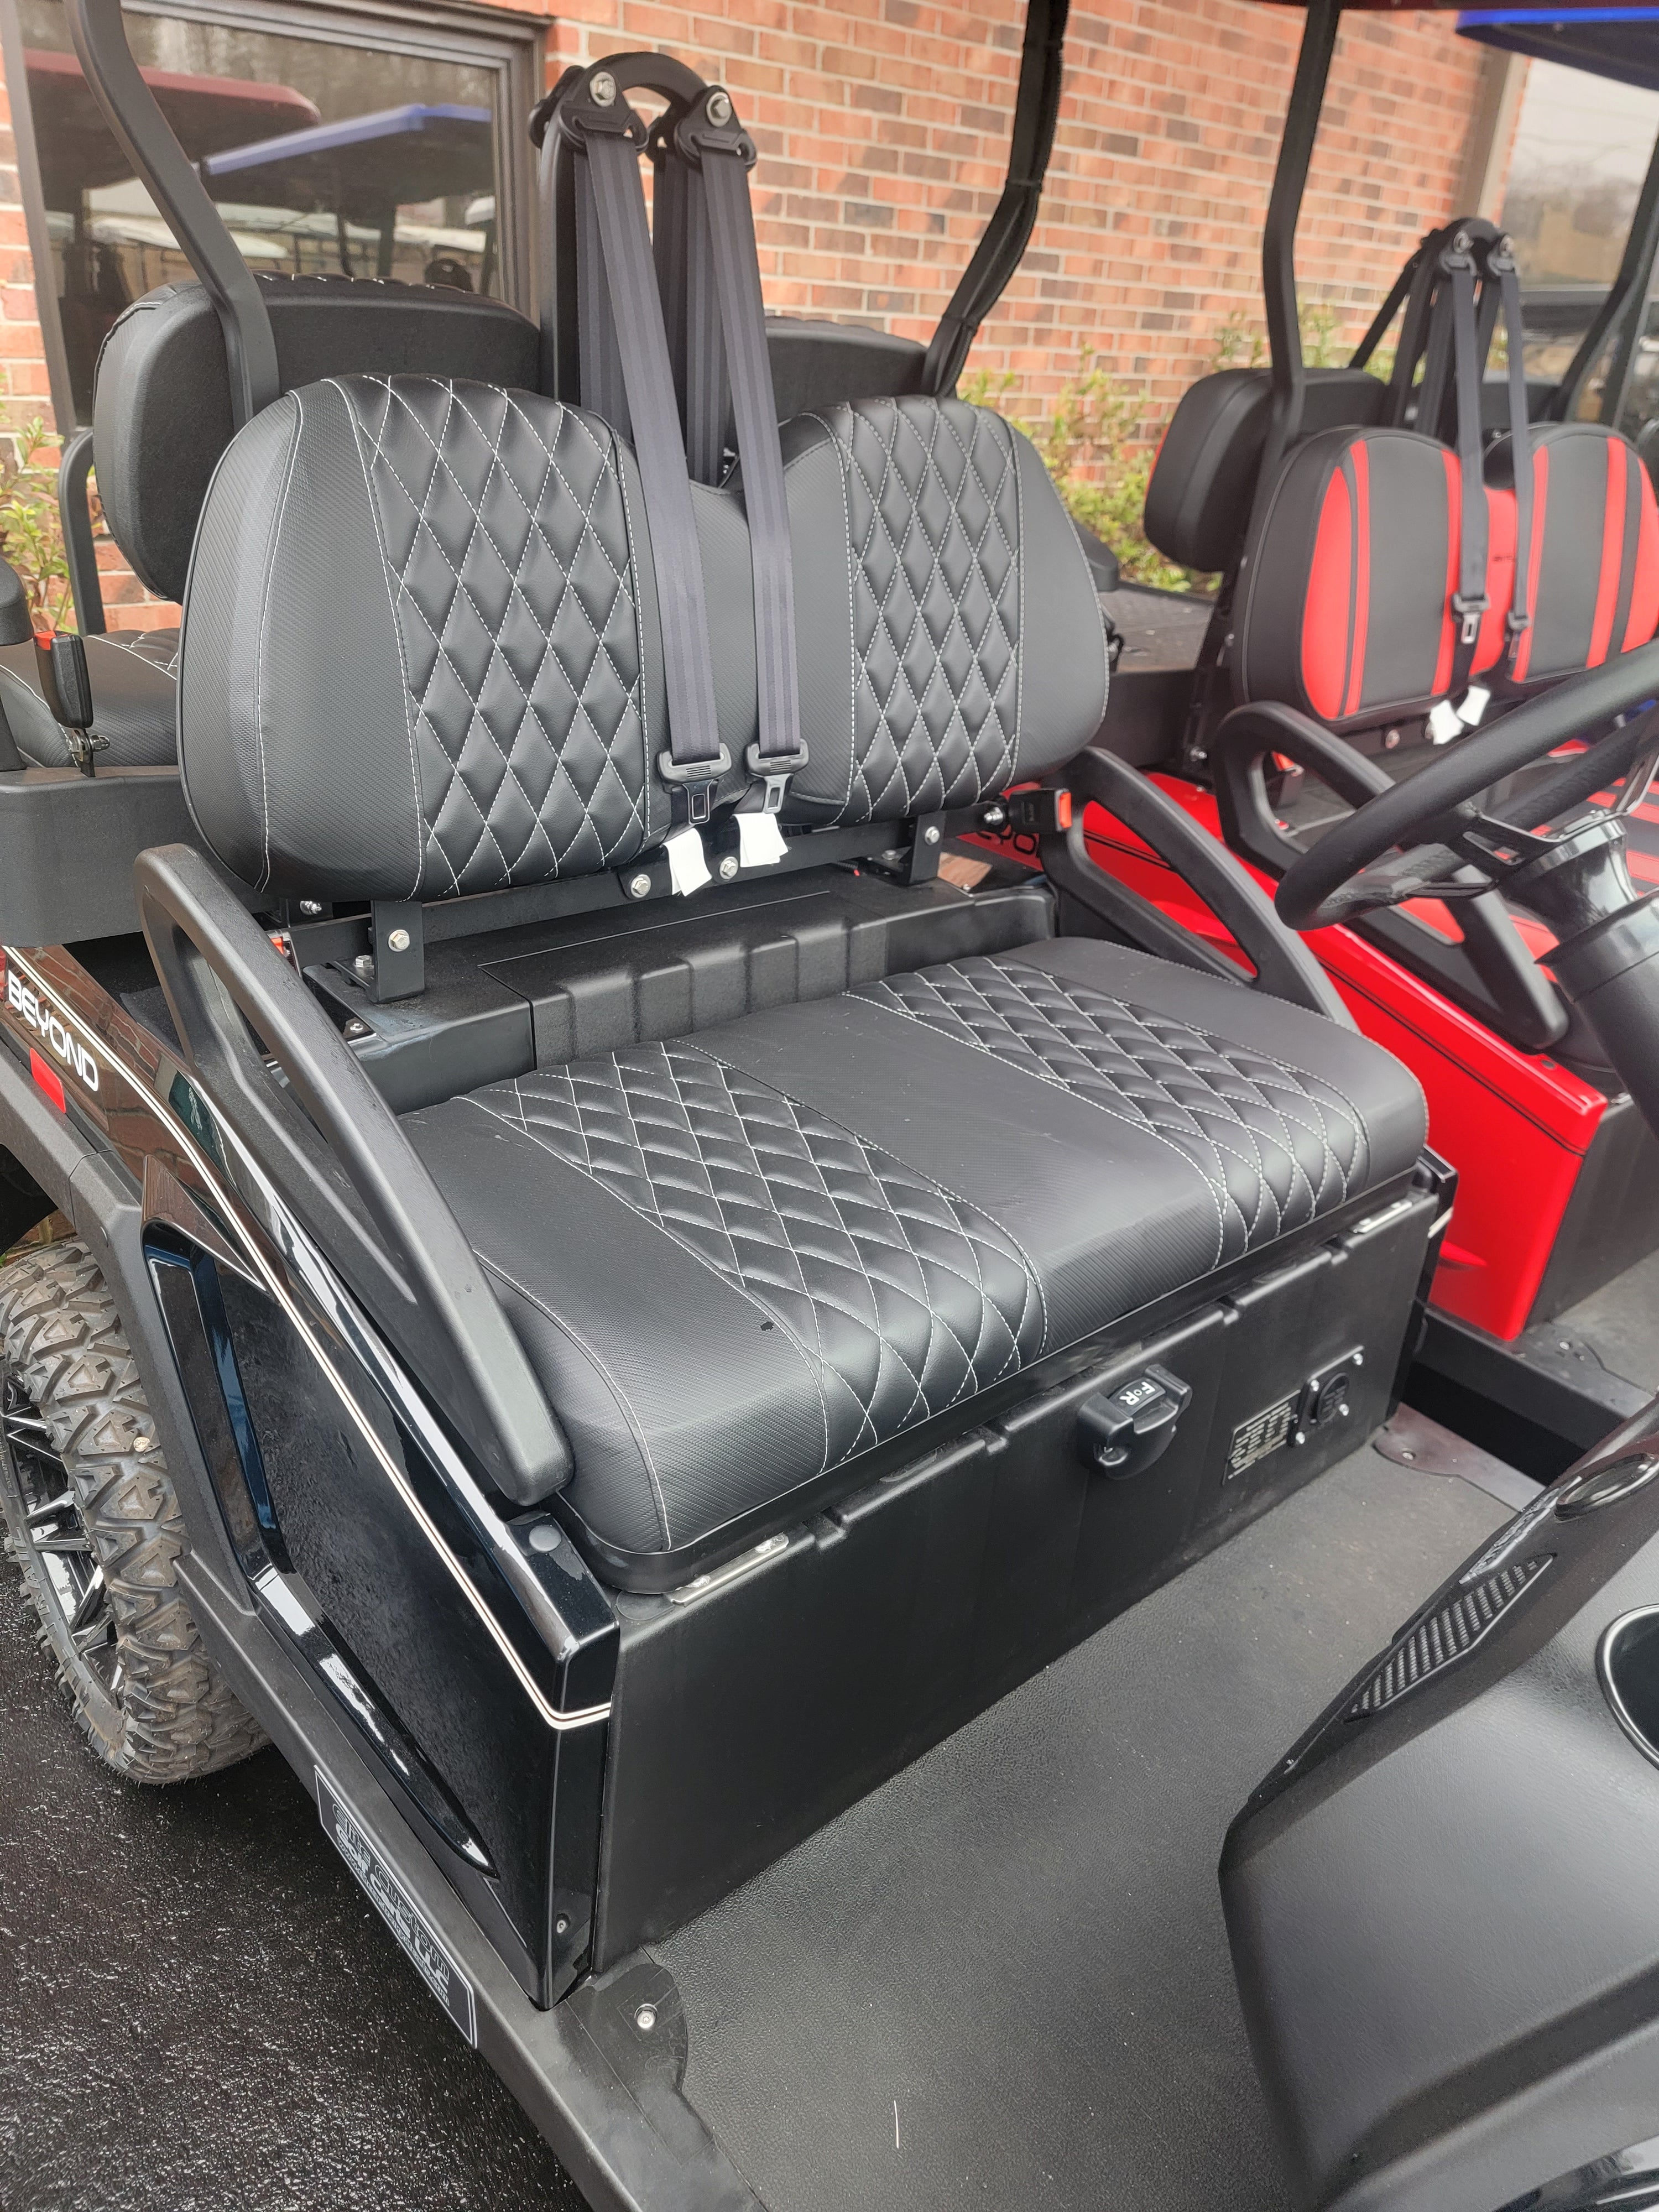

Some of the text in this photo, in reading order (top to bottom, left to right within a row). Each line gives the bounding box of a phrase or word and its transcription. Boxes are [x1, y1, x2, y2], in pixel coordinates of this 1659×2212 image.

[8, 969, 98, 1092] BEYOND
[332, 1803, 450, 1981] Elite Custom
[336, 1823, 448, 1994] Golf Carts LLC
